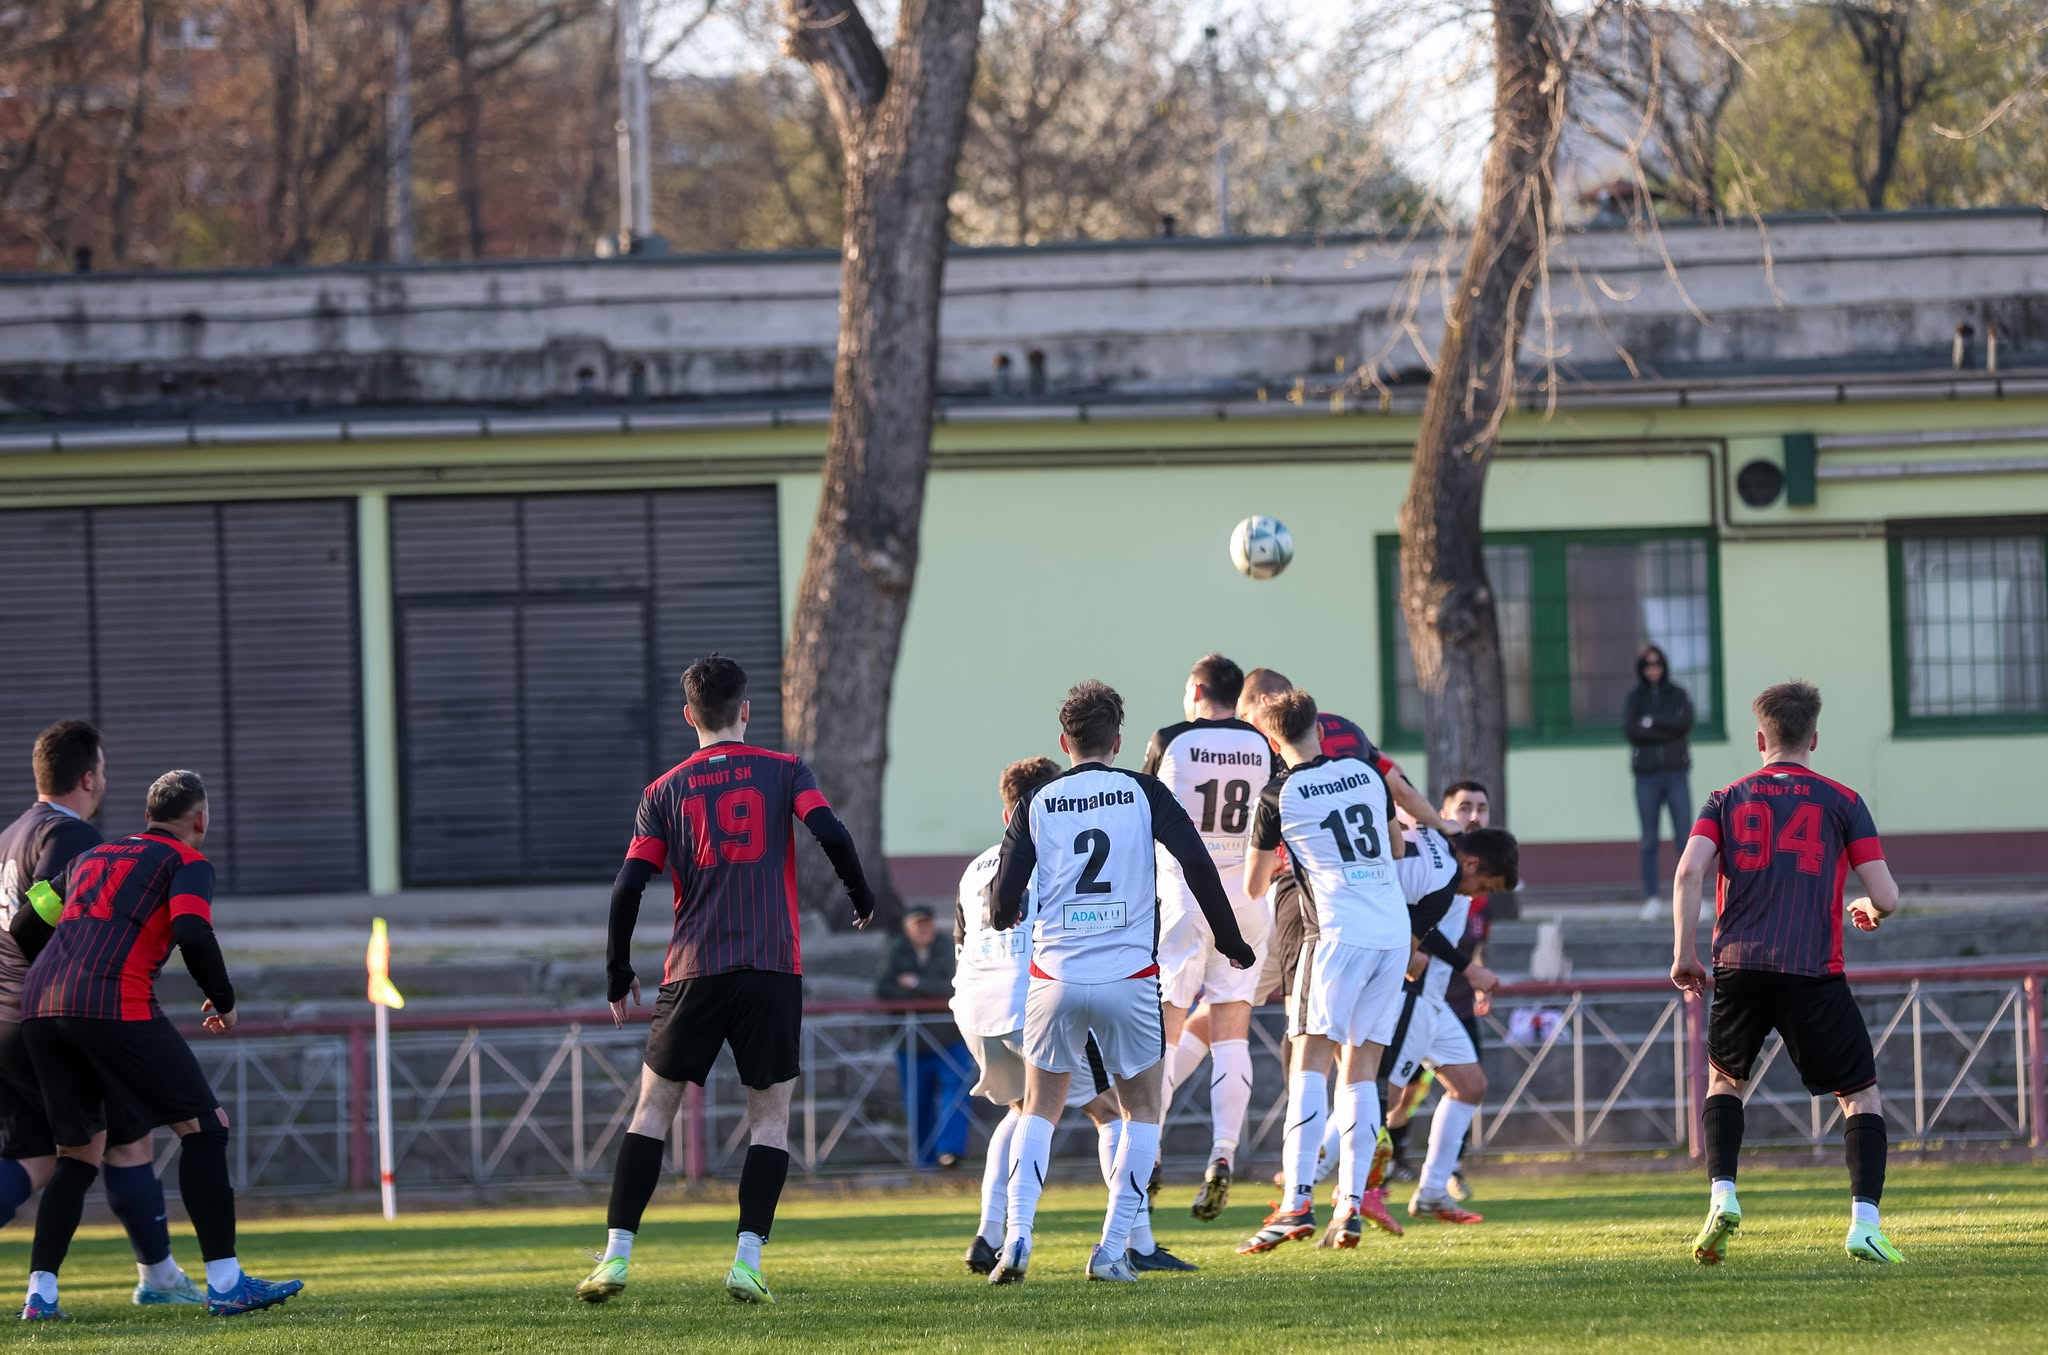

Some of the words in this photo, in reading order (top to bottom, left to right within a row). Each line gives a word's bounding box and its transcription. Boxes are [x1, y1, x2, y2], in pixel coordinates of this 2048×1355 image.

[735, 766, 753, 780] SK
[1190, 747, 1262, 766] Várpalota
[1045, 790, 1135, 813] Várpalota
[1194, 779, 1251, 834] 18
[1298, 773, 1371, 799] Várpalota
[681, 786, 768, 870] 19
[1319, 804, 1381, 862] 13
[1730, 801, 1825, 876] 94
[58, 857, 139, 921] 21
[1073, 828, 1112, 895] 2
